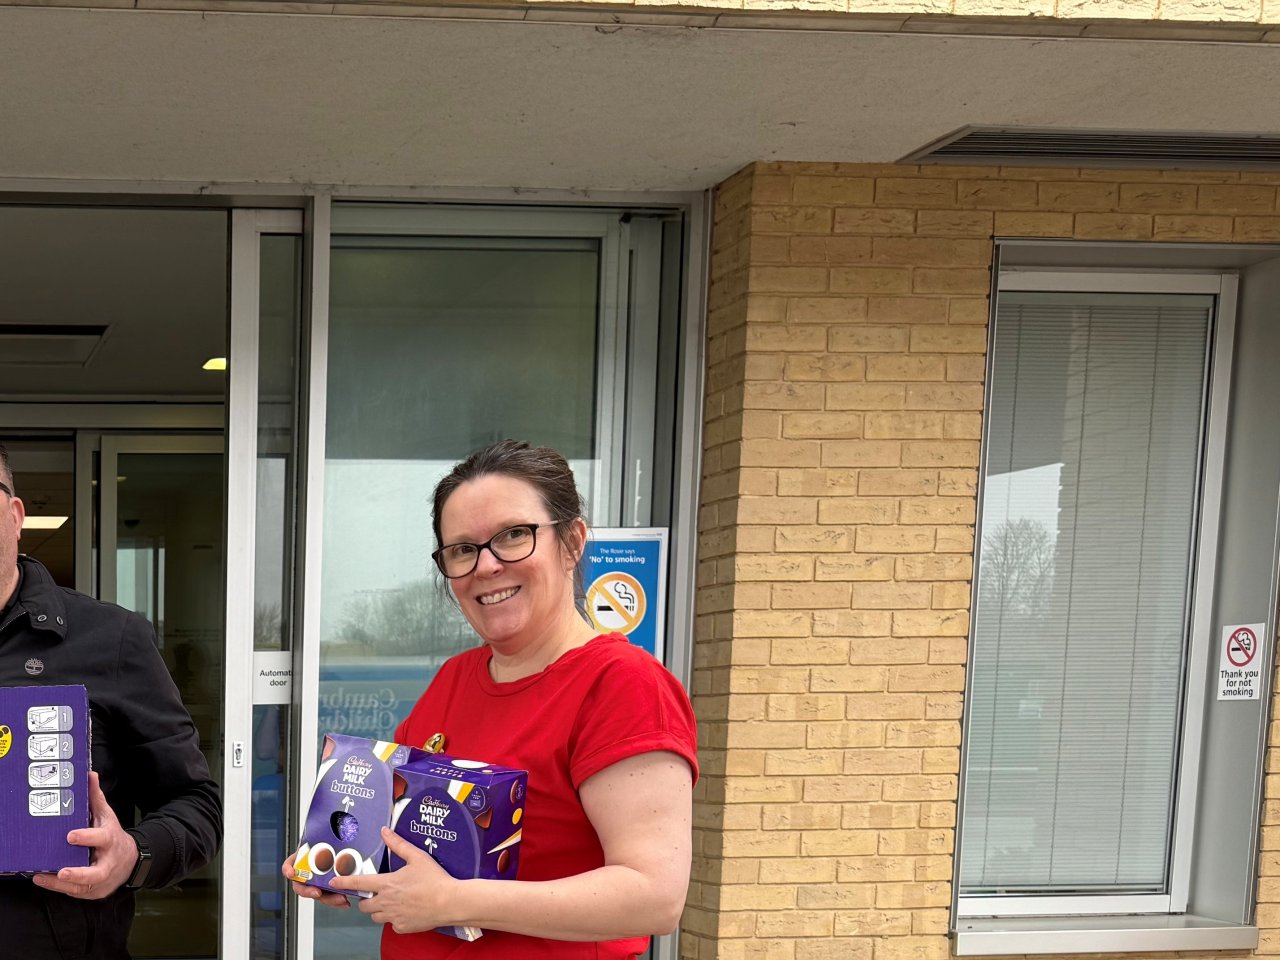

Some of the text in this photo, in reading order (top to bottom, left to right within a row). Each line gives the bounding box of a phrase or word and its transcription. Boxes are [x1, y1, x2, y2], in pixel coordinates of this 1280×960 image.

[615, 555, 646, 564] smoking
[1220, 669, 1259, 680] Thank you
[1226, 678, 1252, 687] for not
[1222, 687, 1254, 697] smoking
[62, 712, 67, 723] 1
[62, 741, 69, 751] 2
[347, 756, 373, 768] Cadbury
[62, 768, 70, 779] 3
[342, 764, 373, 776] DAIRY
[342, 772, 366, 785] MILK
[331, 780, 375, 799] buttons
[422, 795, 450, 810] Cadbury
[419, 804, 451, 818] DAIRY
[420, 813, 445, 827] MILK
[410, 820, 457, 841] buttons
